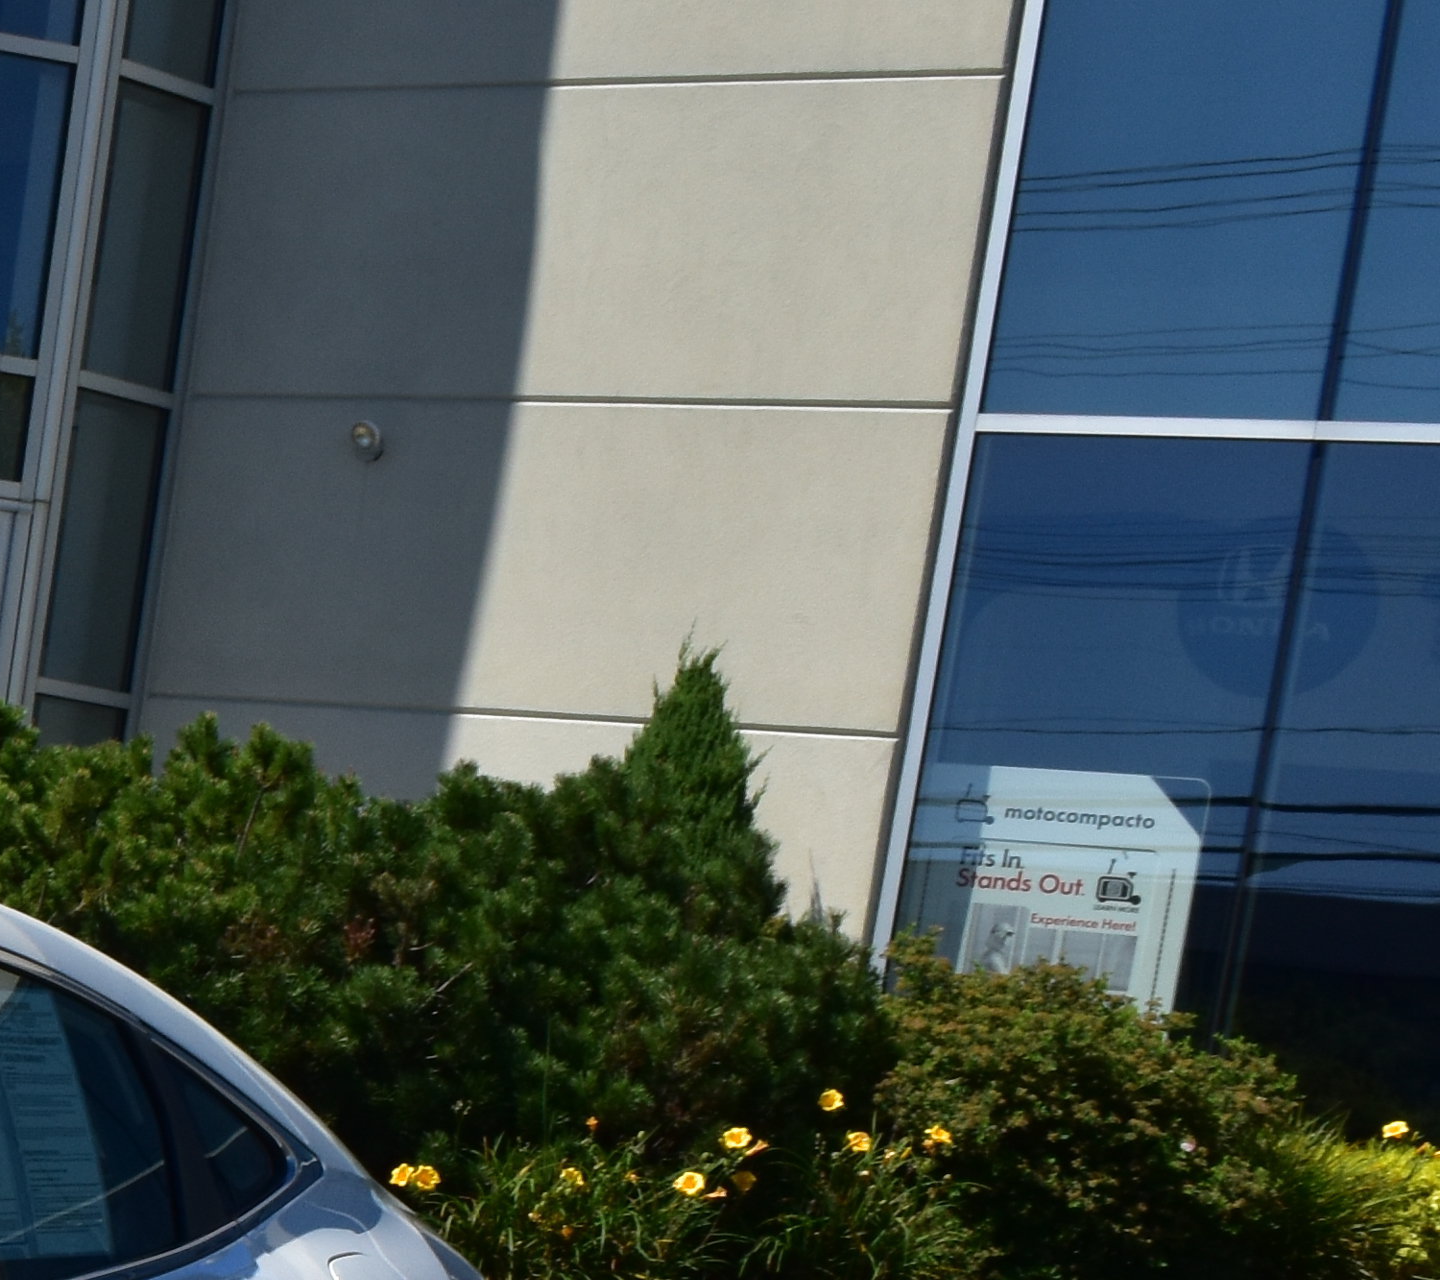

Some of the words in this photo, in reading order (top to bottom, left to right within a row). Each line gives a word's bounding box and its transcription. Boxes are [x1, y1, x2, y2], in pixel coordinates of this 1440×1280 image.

[1004, 806, 1155, 830] motocompacto
[960, 845, 995, 867] Fits
[956, 867, 1032, 892] Stands
[1039, 873, 1086, 896] Out.
[1030, 912, 1099, 929] Experience
[1102, 918, 1137, 931] Here!
